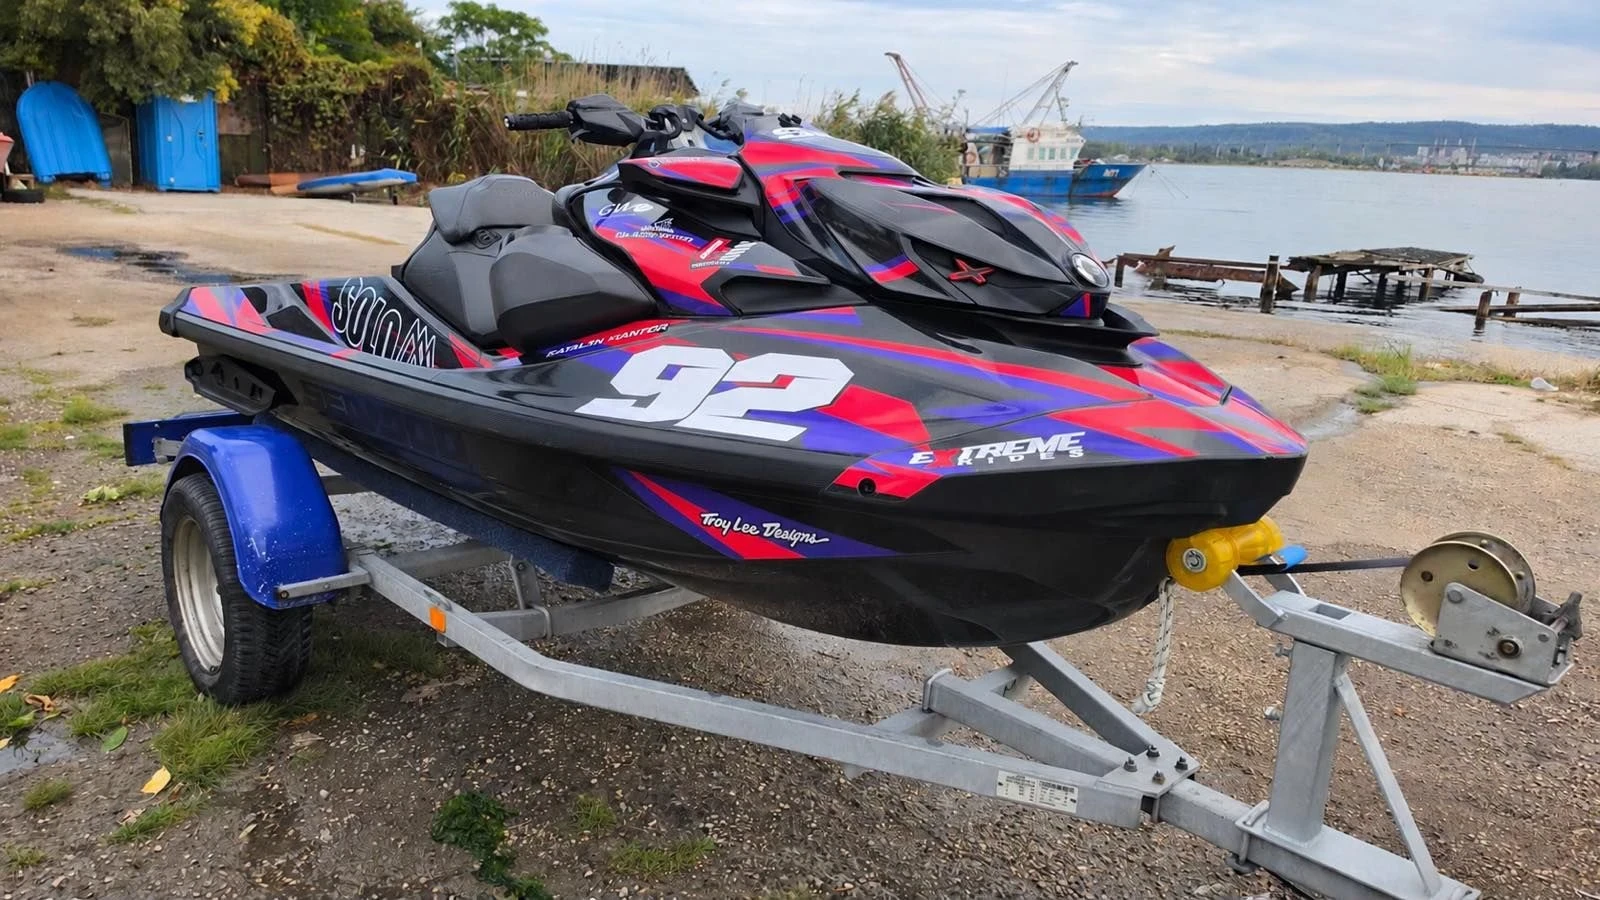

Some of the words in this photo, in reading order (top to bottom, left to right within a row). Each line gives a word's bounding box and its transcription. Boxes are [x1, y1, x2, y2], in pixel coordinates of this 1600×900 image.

[574, 345, 855, 442] 92
[908, 431, 1086, 468] EXTREME
[957, 448, 1085, 466] RIDES
[700, 513, 731, 536] Troy
[733, 517, 760, 535] Lee
[762, 522, 830, 547] Designs
